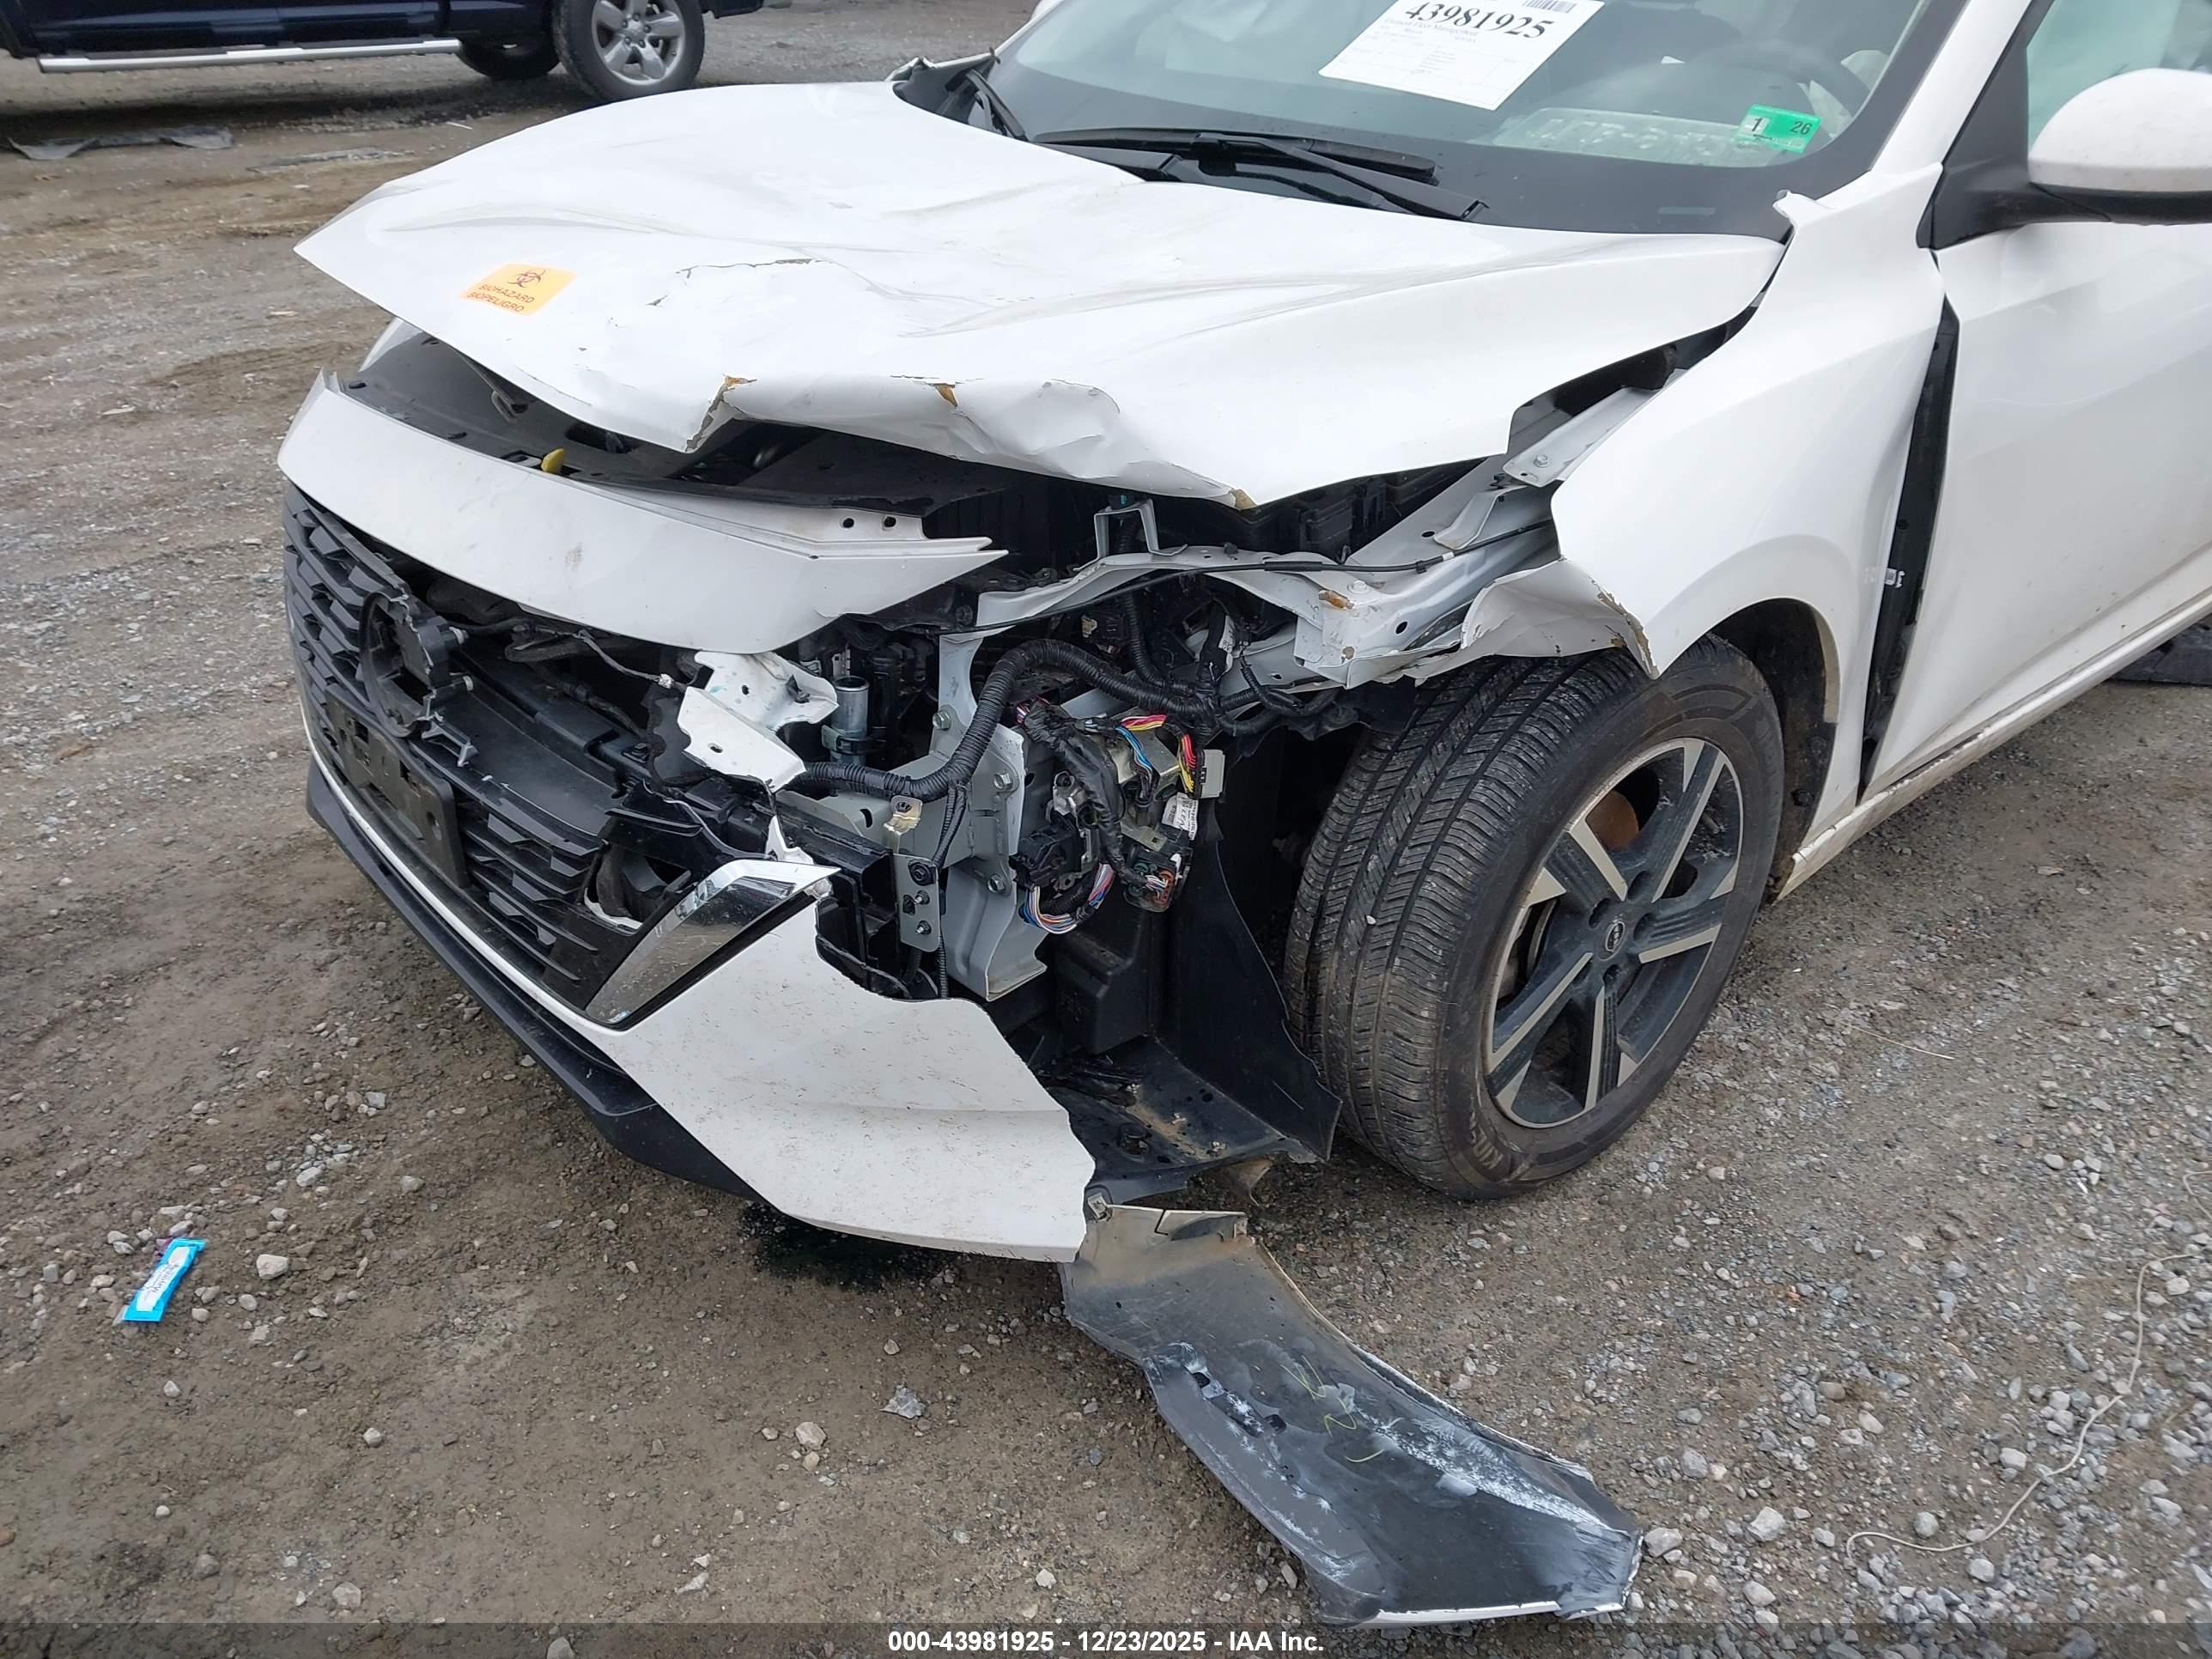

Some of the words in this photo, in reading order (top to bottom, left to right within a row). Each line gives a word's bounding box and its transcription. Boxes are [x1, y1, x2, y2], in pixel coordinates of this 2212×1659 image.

[1405, 1, 1554, 38] 43981925
[1752, 117, 1763, 132] 1
[1790, 120, 1813, 136] 26
[477, 283, 535, 303] BIOHAZARD
